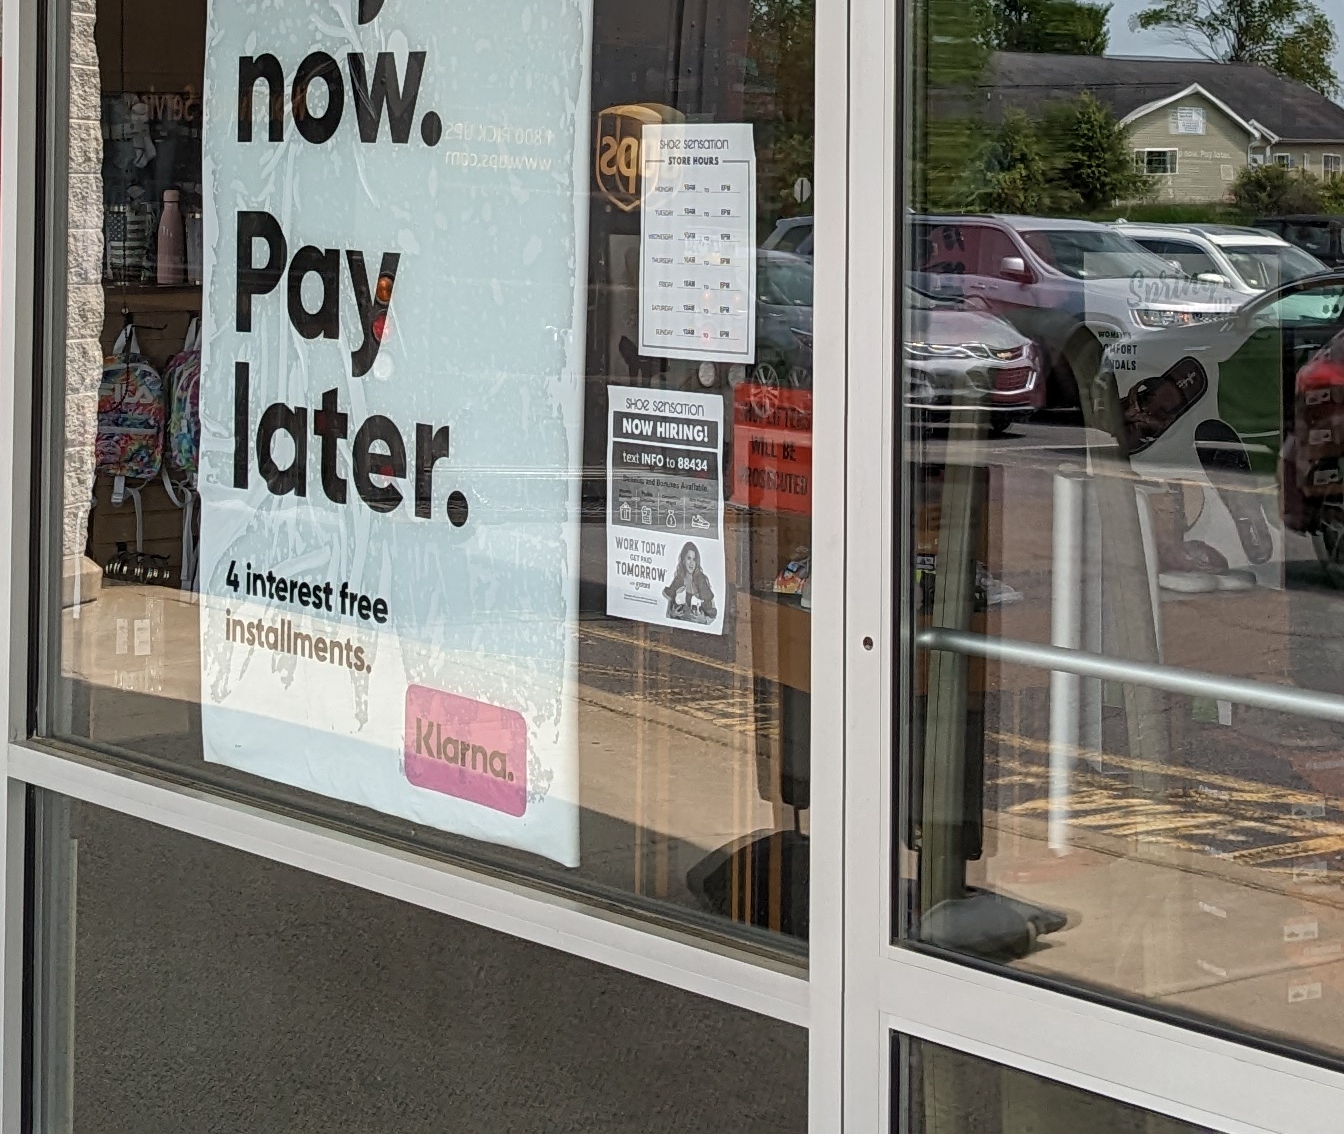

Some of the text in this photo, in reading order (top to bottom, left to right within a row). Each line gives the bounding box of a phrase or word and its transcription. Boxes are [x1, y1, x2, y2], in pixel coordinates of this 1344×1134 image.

[237, 50, 442, 147] now.
[668, 156, 719, 166] STORE HOURS
[236, 210, 402, 378] Pay
[233, 361, 468, 528] later.
[622, 417, 709, 443] NOW HIRING!
[622, 450, 708, 472] text INFO to 88434
[615, 536, 666, 557] WORK TODAY
[629, 554, 640, 562] GET
[225, 560, 389, 624] 4 interest free
[615, 561, 666, 583] TOMORROW
[225, 607, 372, 674] installments.
[415, 717, 514, 782] Klarna.
